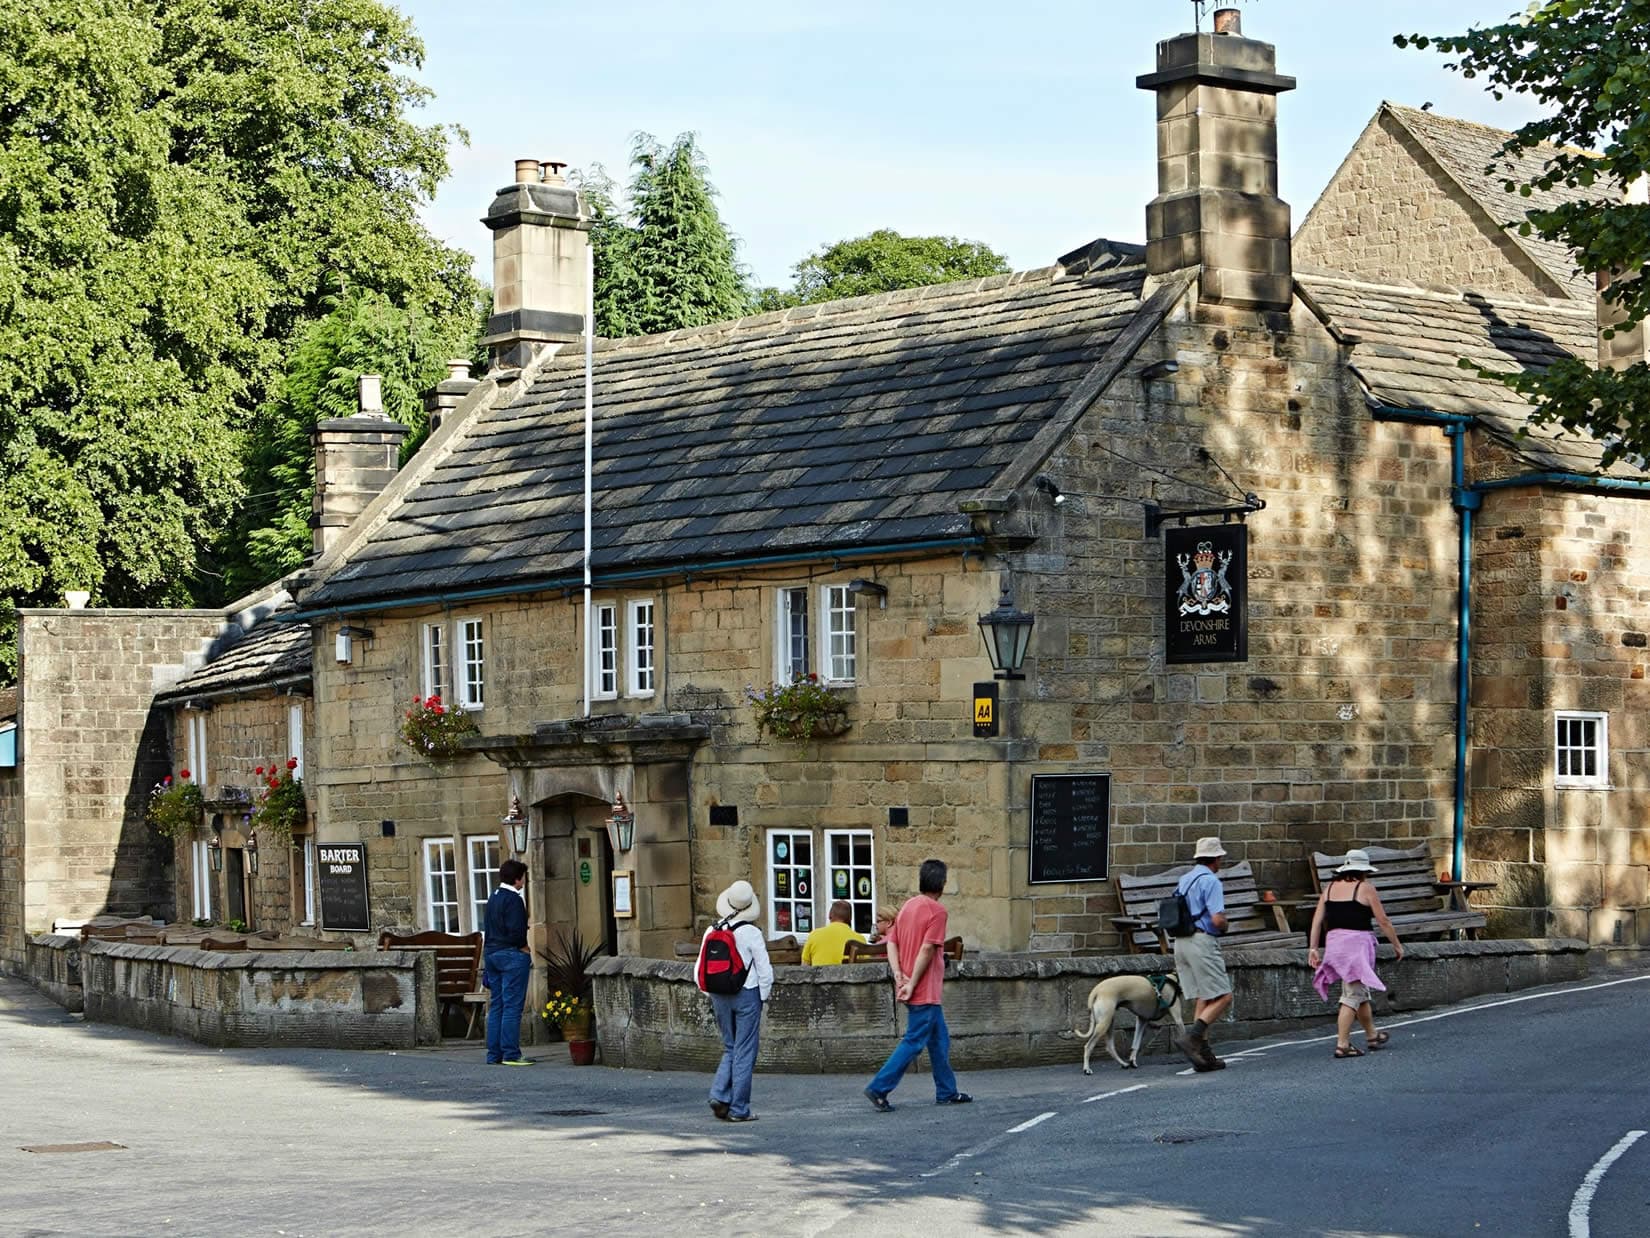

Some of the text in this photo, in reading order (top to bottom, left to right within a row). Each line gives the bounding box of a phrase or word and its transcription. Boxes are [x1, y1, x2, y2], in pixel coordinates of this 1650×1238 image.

[1180, 618, 1230, 632] DEVONSHIRE
[1192, 633, 1217, 646] ARMS
[977, 705, 990, 718] AA
[320, 849, 360, 864] BARTER
[330, 864, 352, 874] BOARD
